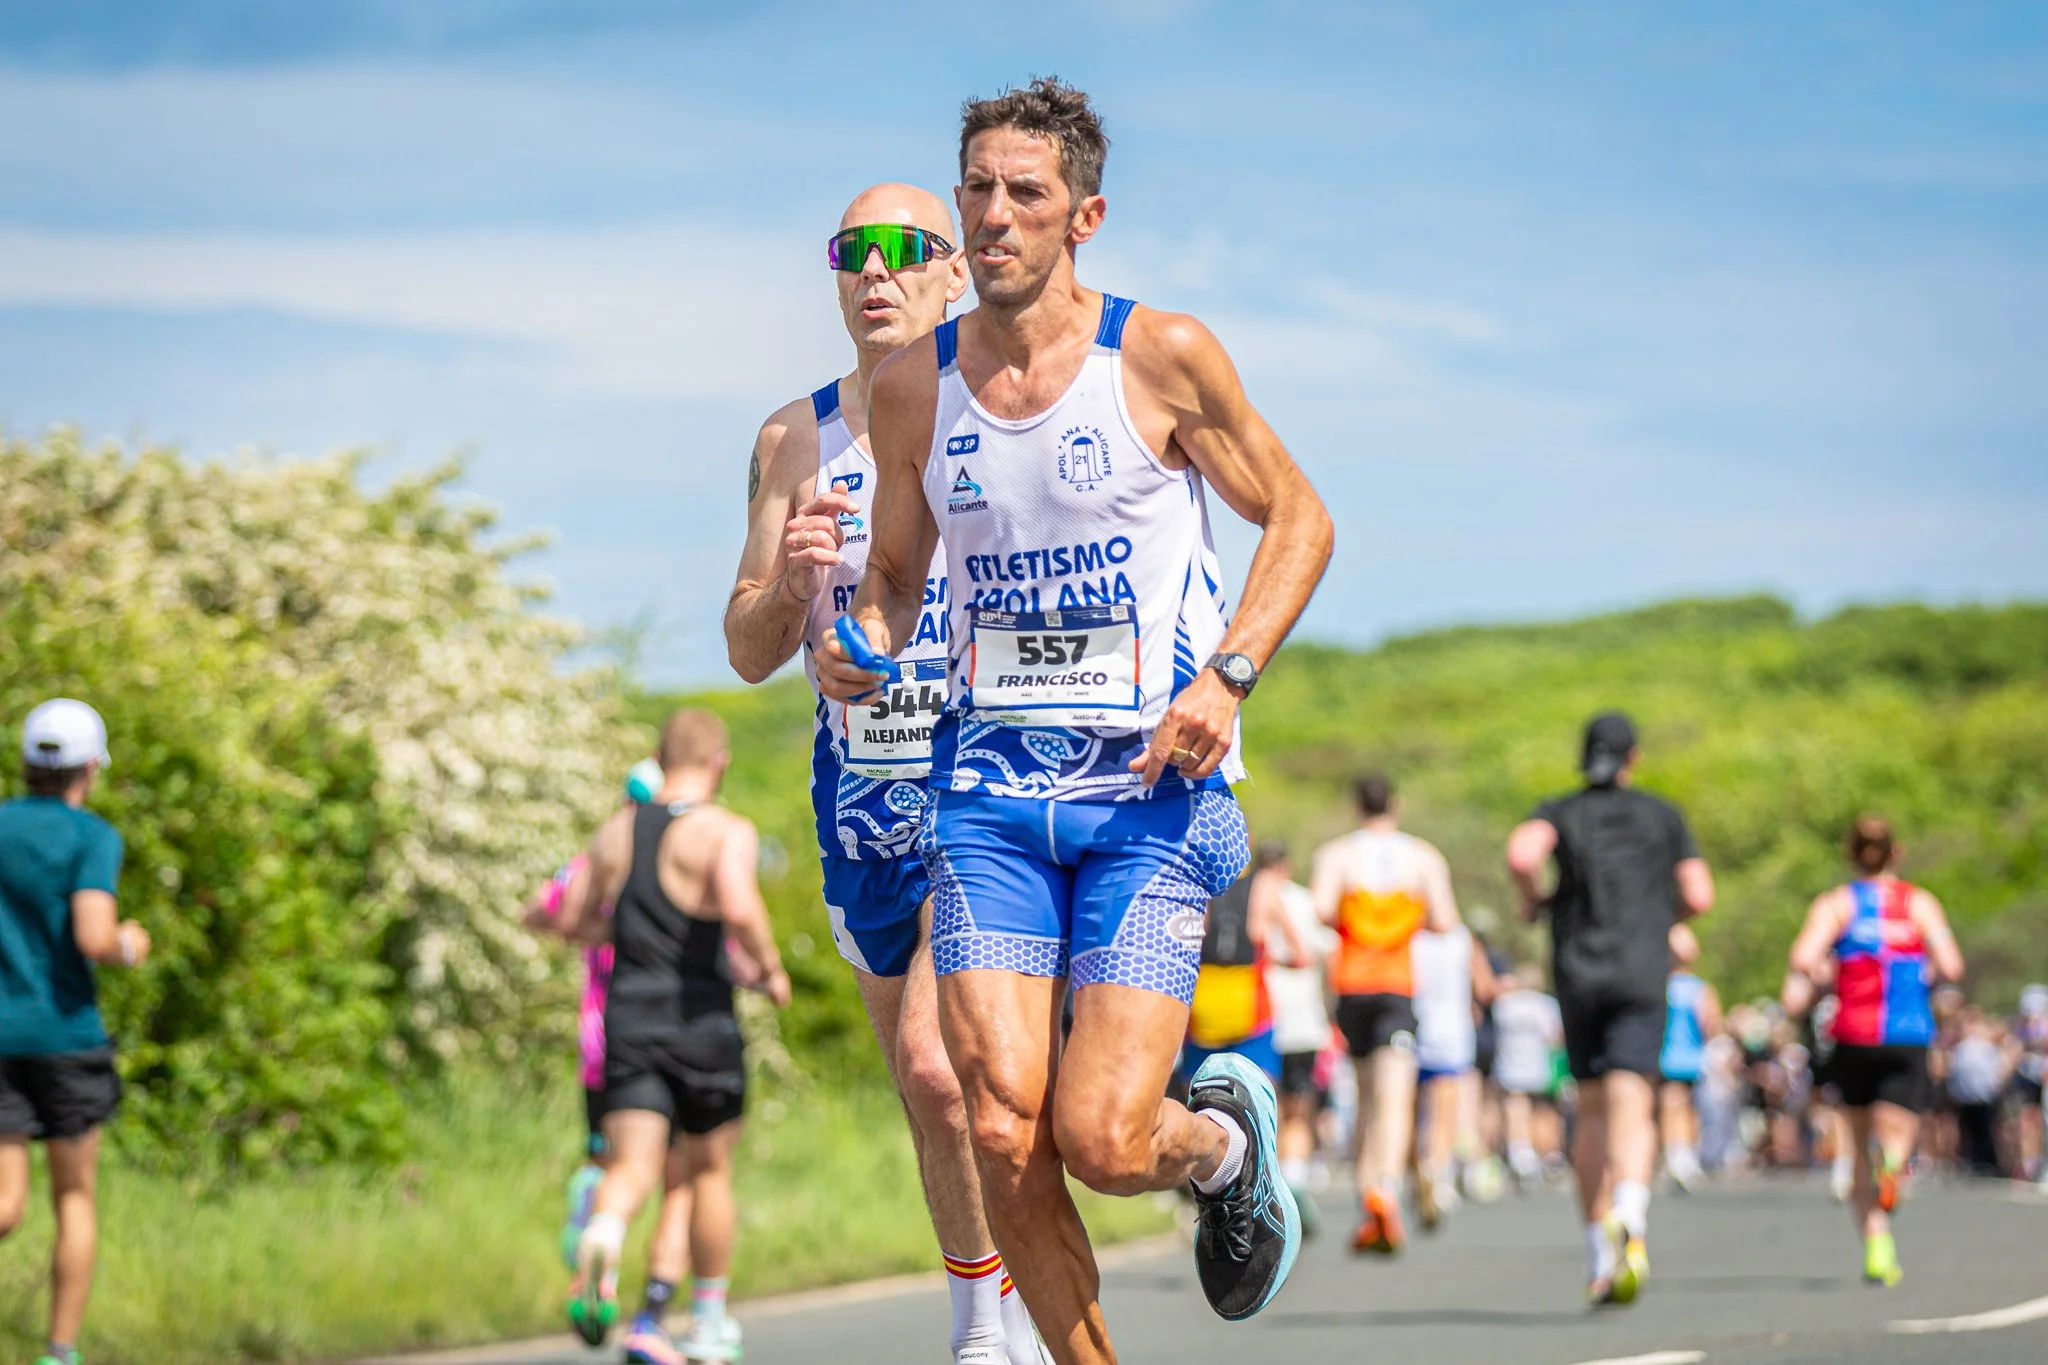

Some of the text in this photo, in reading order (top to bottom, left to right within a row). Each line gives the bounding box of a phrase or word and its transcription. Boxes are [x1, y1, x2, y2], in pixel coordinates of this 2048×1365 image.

[1058, 426, 1112, 480] APOL ANA ALICANTE
[1075, 455, 1087, 465] 21
[948, 500, 988, 513] Alicante
[965, 536, 1133, 582] ATLETISMO
[1016, 634, 1089, 666] 557
[997, 671, 1108, 688] FRANCISCO
[870, 685, 945, 720] 544
[863, 726, 932, 744] ALEJAND
[960, 1351, 989, 1360] saucony
